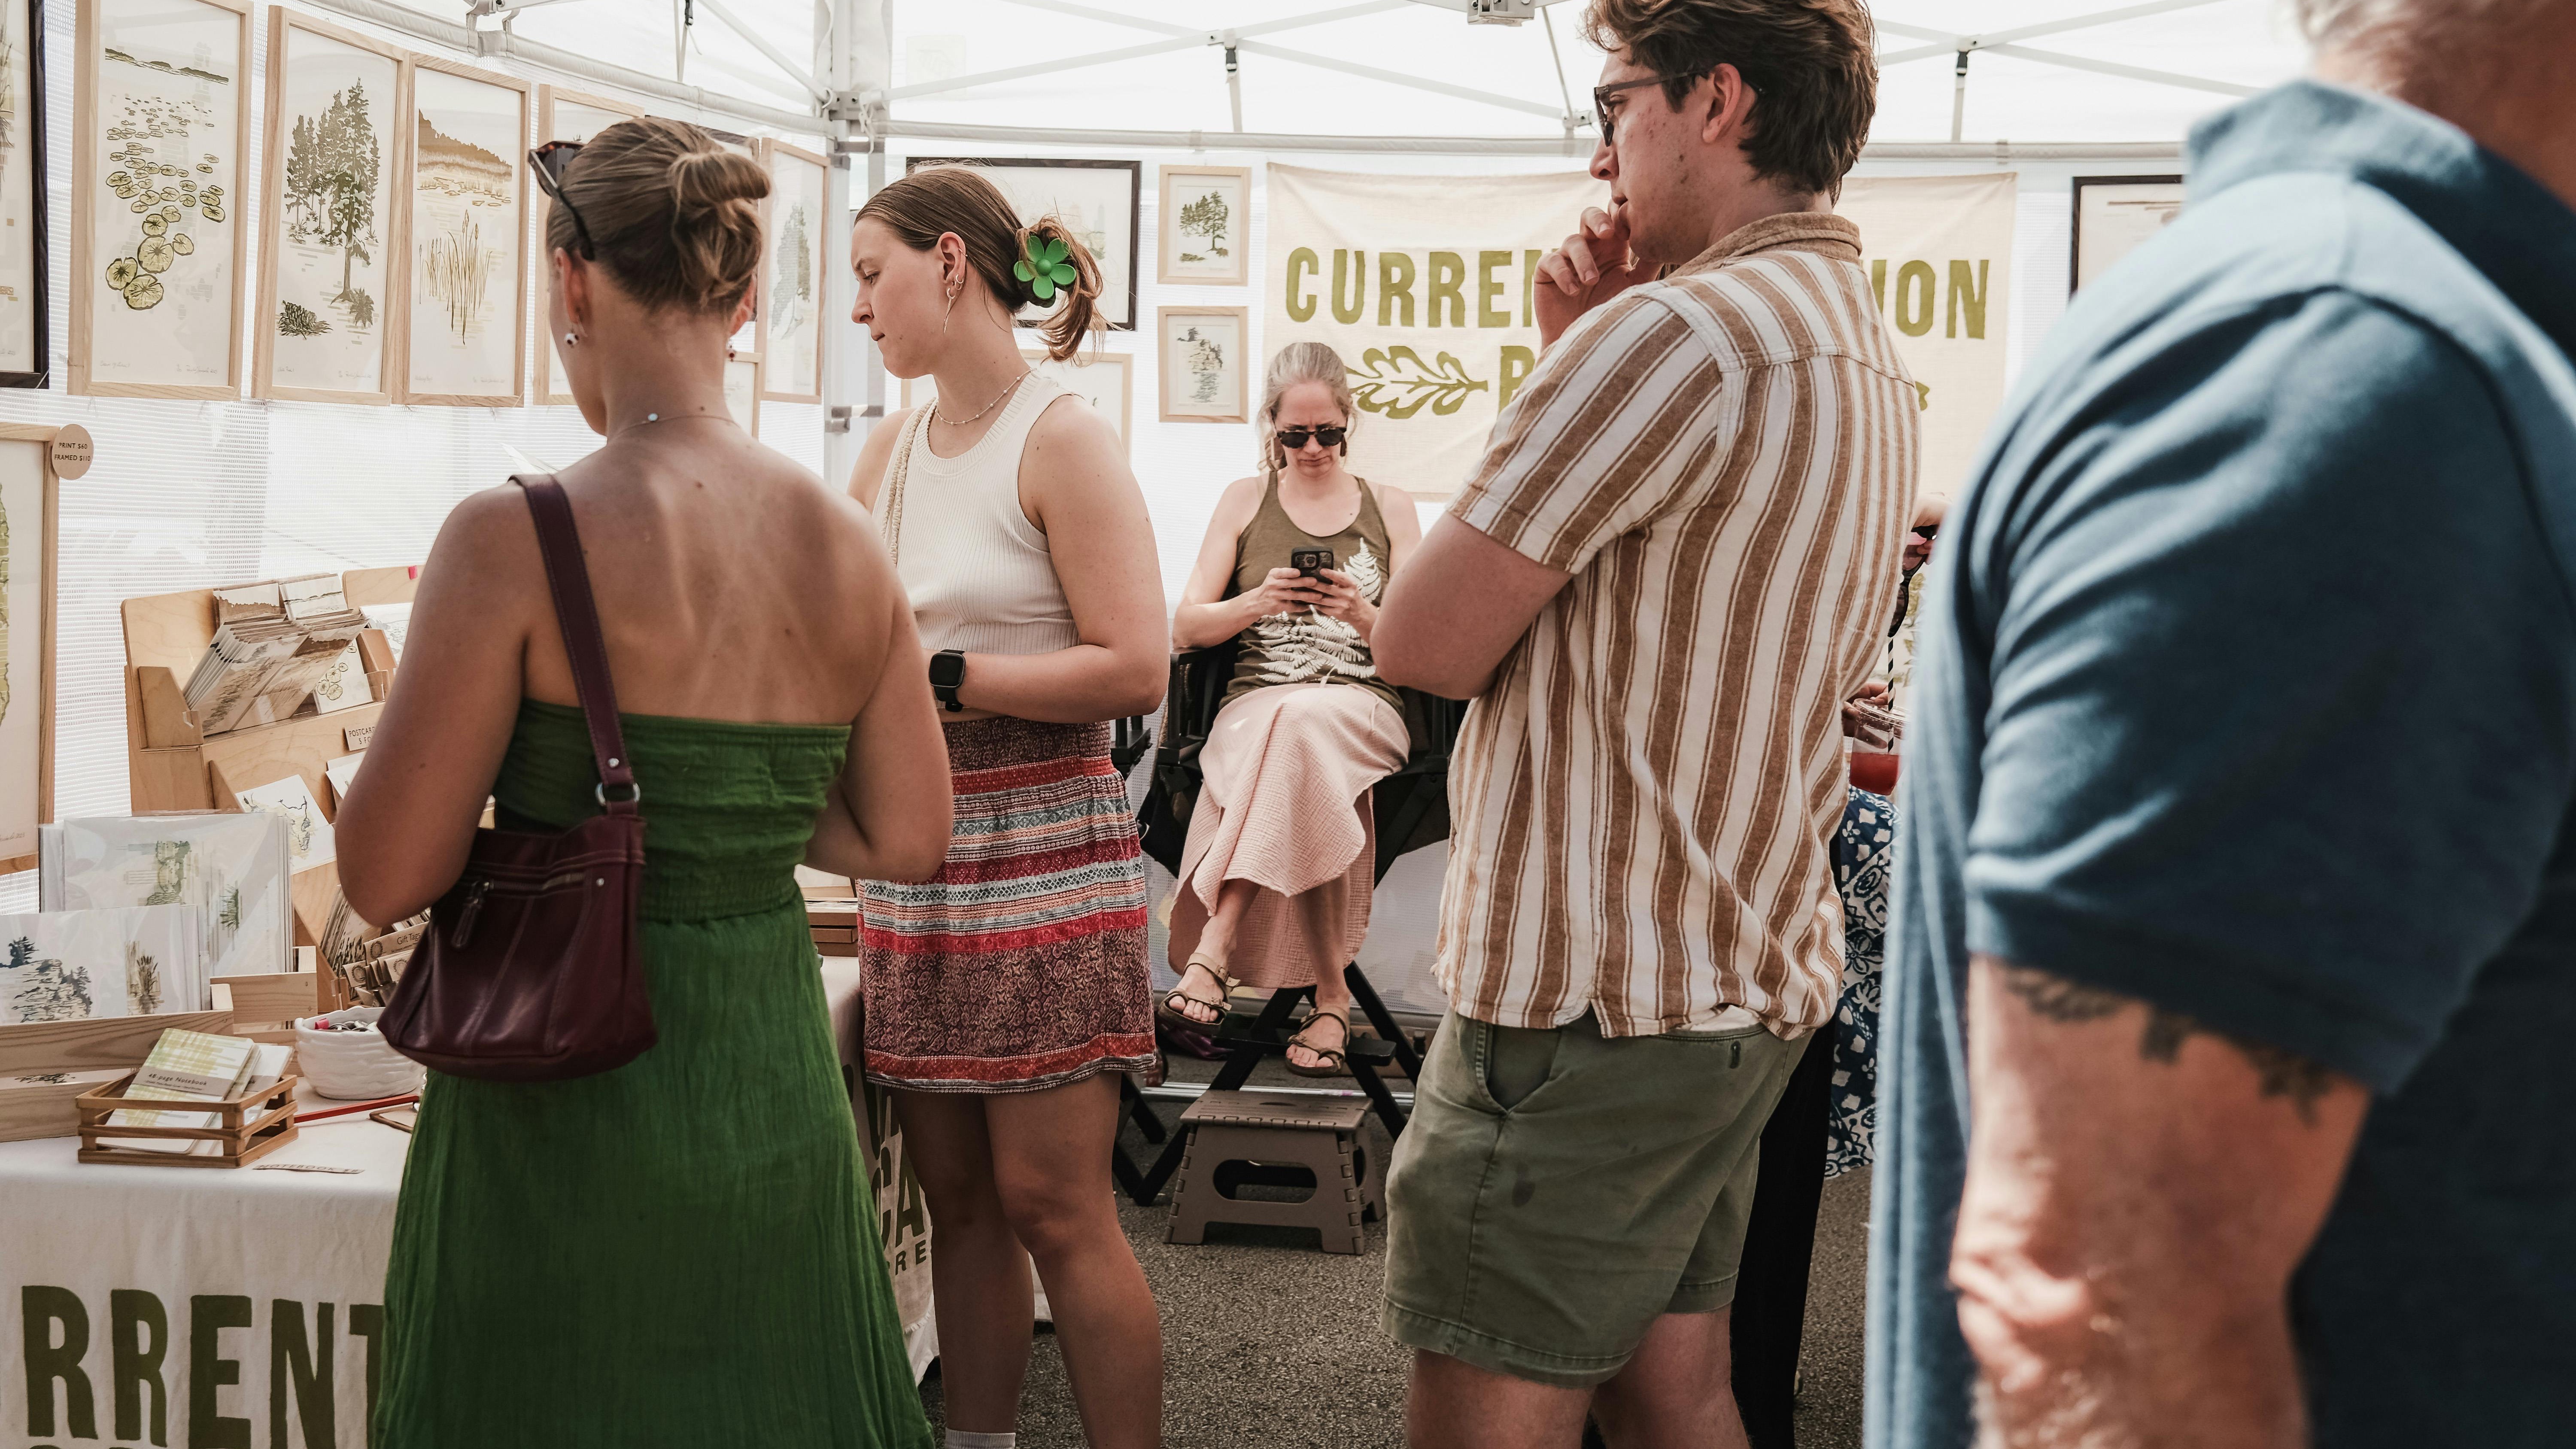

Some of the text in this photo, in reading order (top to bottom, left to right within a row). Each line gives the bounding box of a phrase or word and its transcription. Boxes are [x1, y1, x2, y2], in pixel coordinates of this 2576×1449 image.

[1286, 247, 1559, 328] CURREN
[397, 935, 408, 945] Gift
[175, 1077, 207, 1085] Notebook
